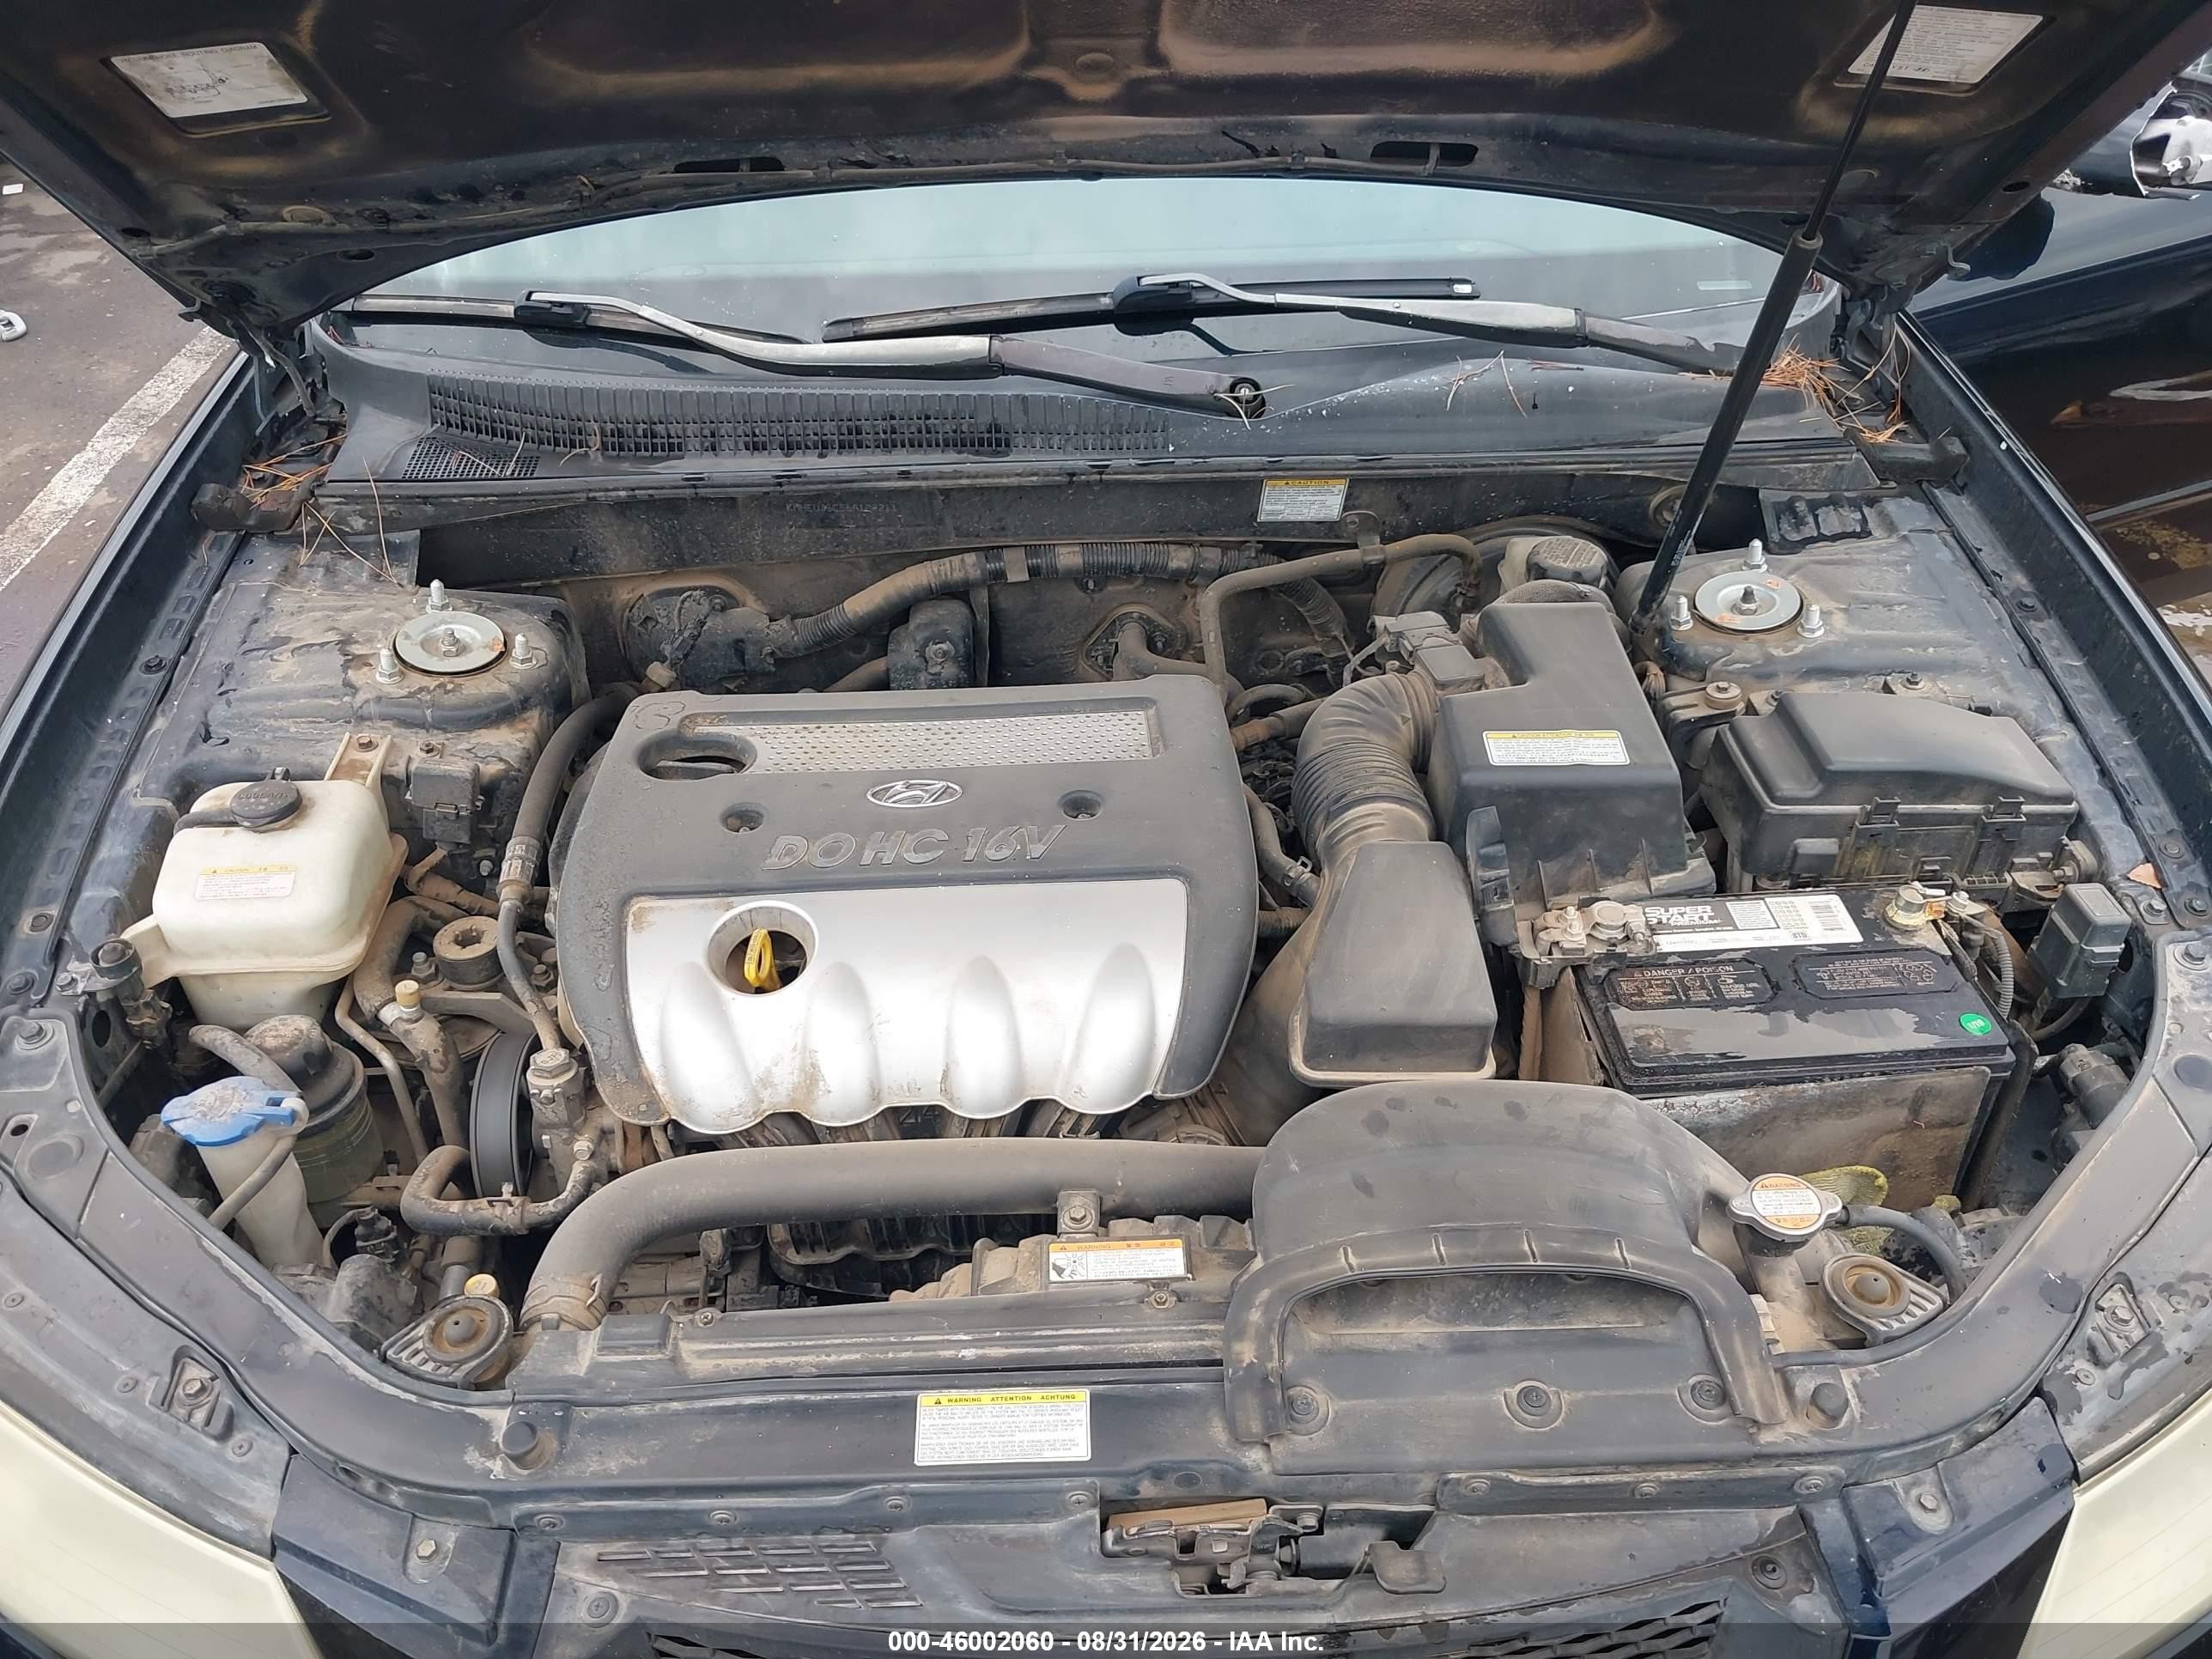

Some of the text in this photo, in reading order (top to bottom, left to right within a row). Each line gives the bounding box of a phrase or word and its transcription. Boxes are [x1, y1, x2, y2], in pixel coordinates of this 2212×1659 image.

[962, 824, 1067, 863] 16V
[1644, 905, 1712, 915] SUPER
[1644, 913, 1715, 925] START
[1644, 968, 1685, 977] DANGER
[1696, 965, 1734, 975] POISON
